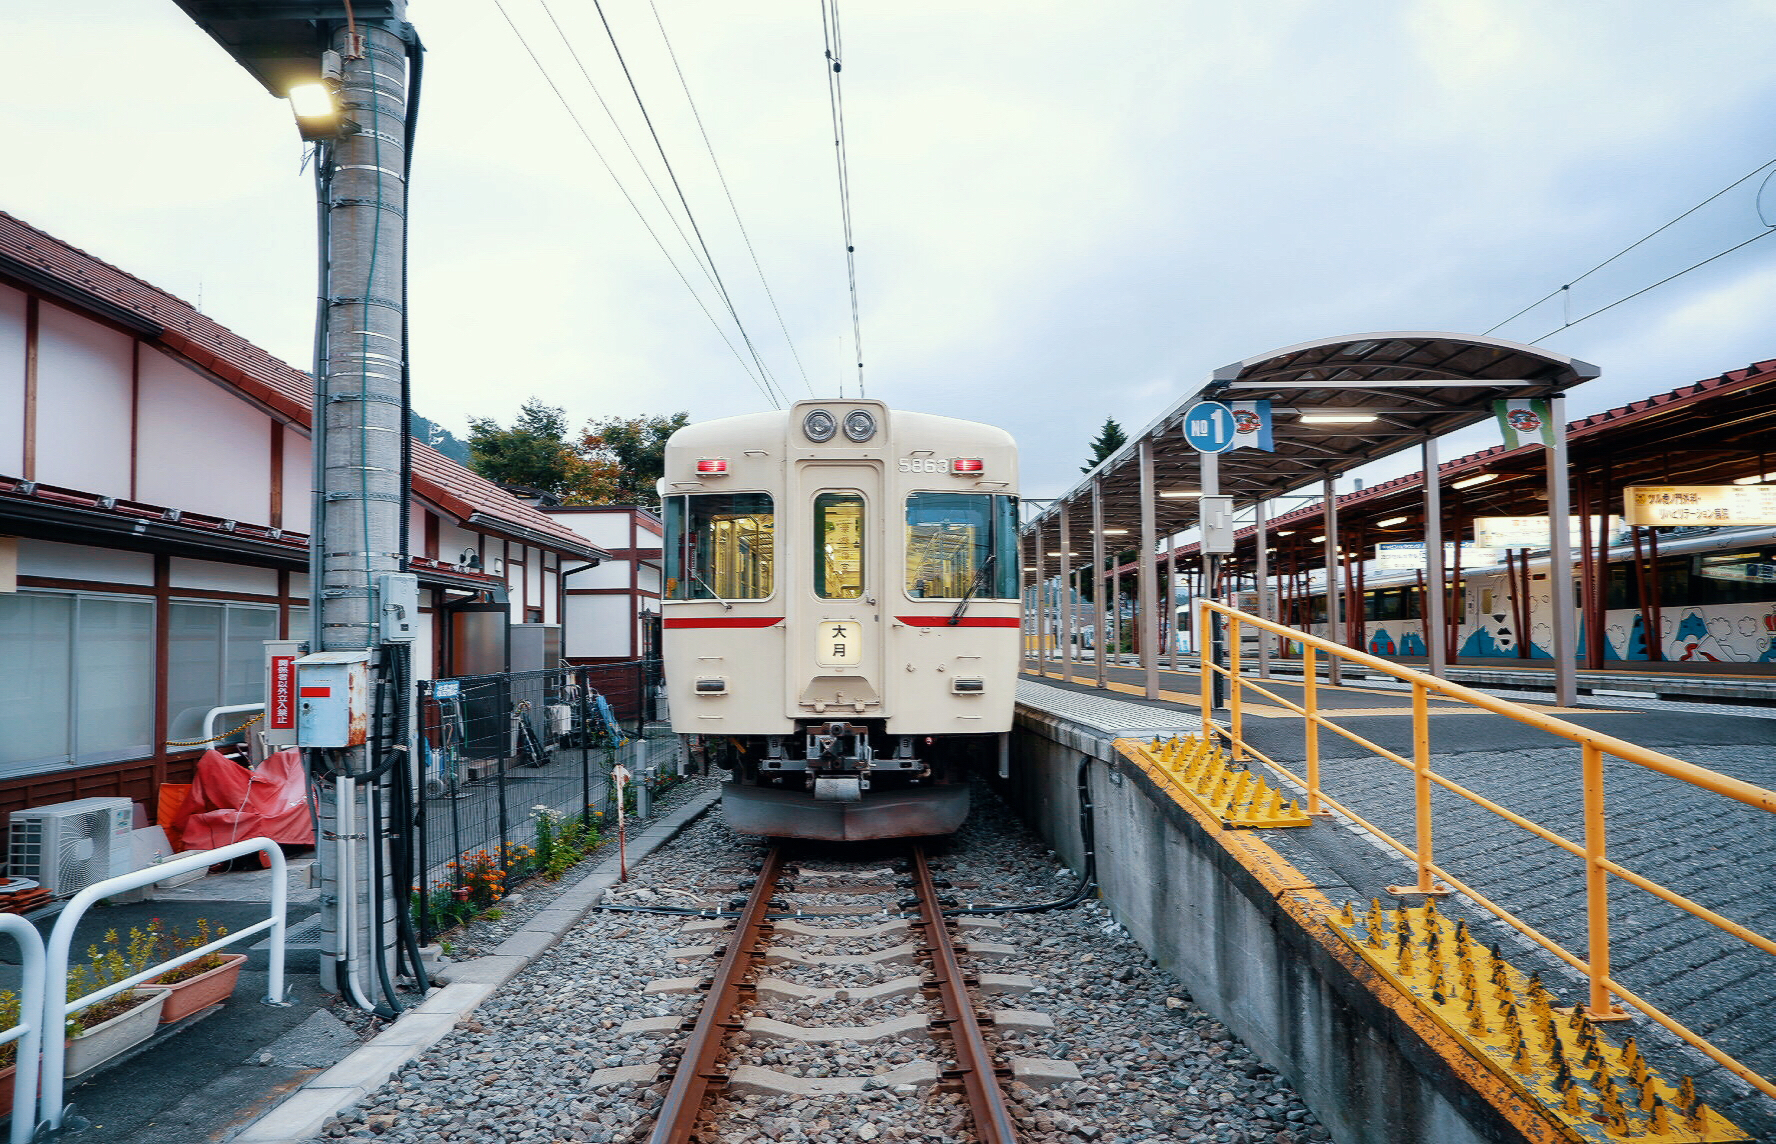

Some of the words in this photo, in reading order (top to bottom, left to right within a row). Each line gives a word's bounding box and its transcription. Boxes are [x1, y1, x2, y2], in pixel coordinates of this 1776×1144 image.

[1211, 409, 1224, 444] 1
[898, 458, 949, 474] 5863
[832, 624, 847, 657] 大月
[277, 659, 289, 724] 関係者以外立入禁止
